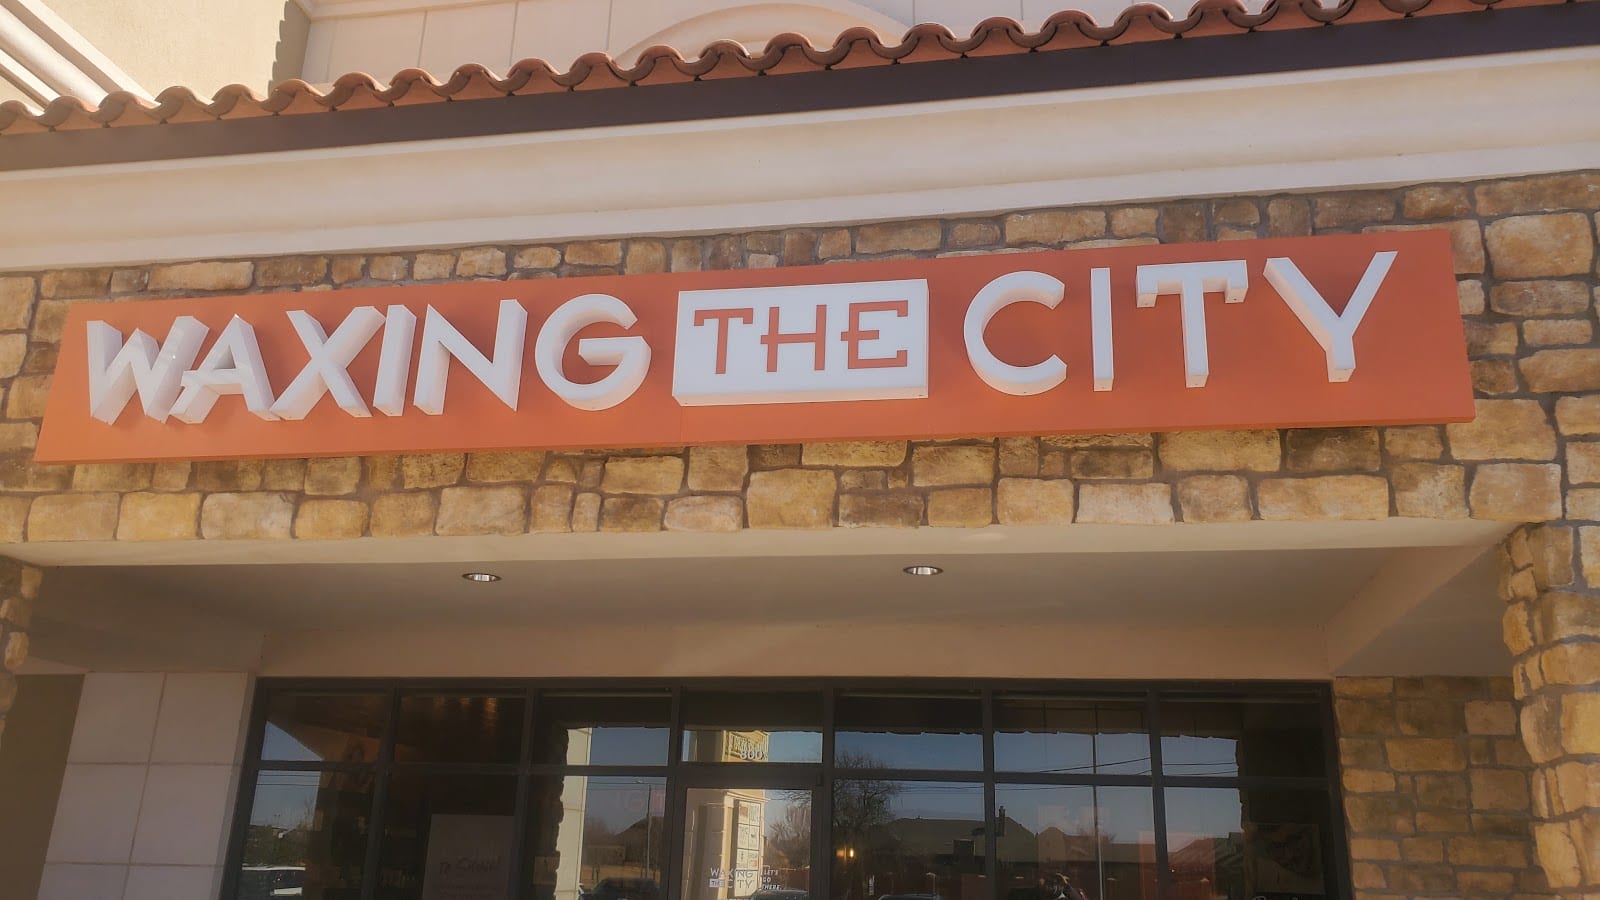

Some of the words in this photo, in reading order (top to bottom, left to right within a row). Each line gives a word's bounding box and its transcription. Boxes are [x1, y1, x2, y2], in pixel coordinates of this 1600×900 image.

[86, 293, 652, 424] WAXING
[693, 299, 909, 375] THE
[964, 250, 1399, 396] CITY
